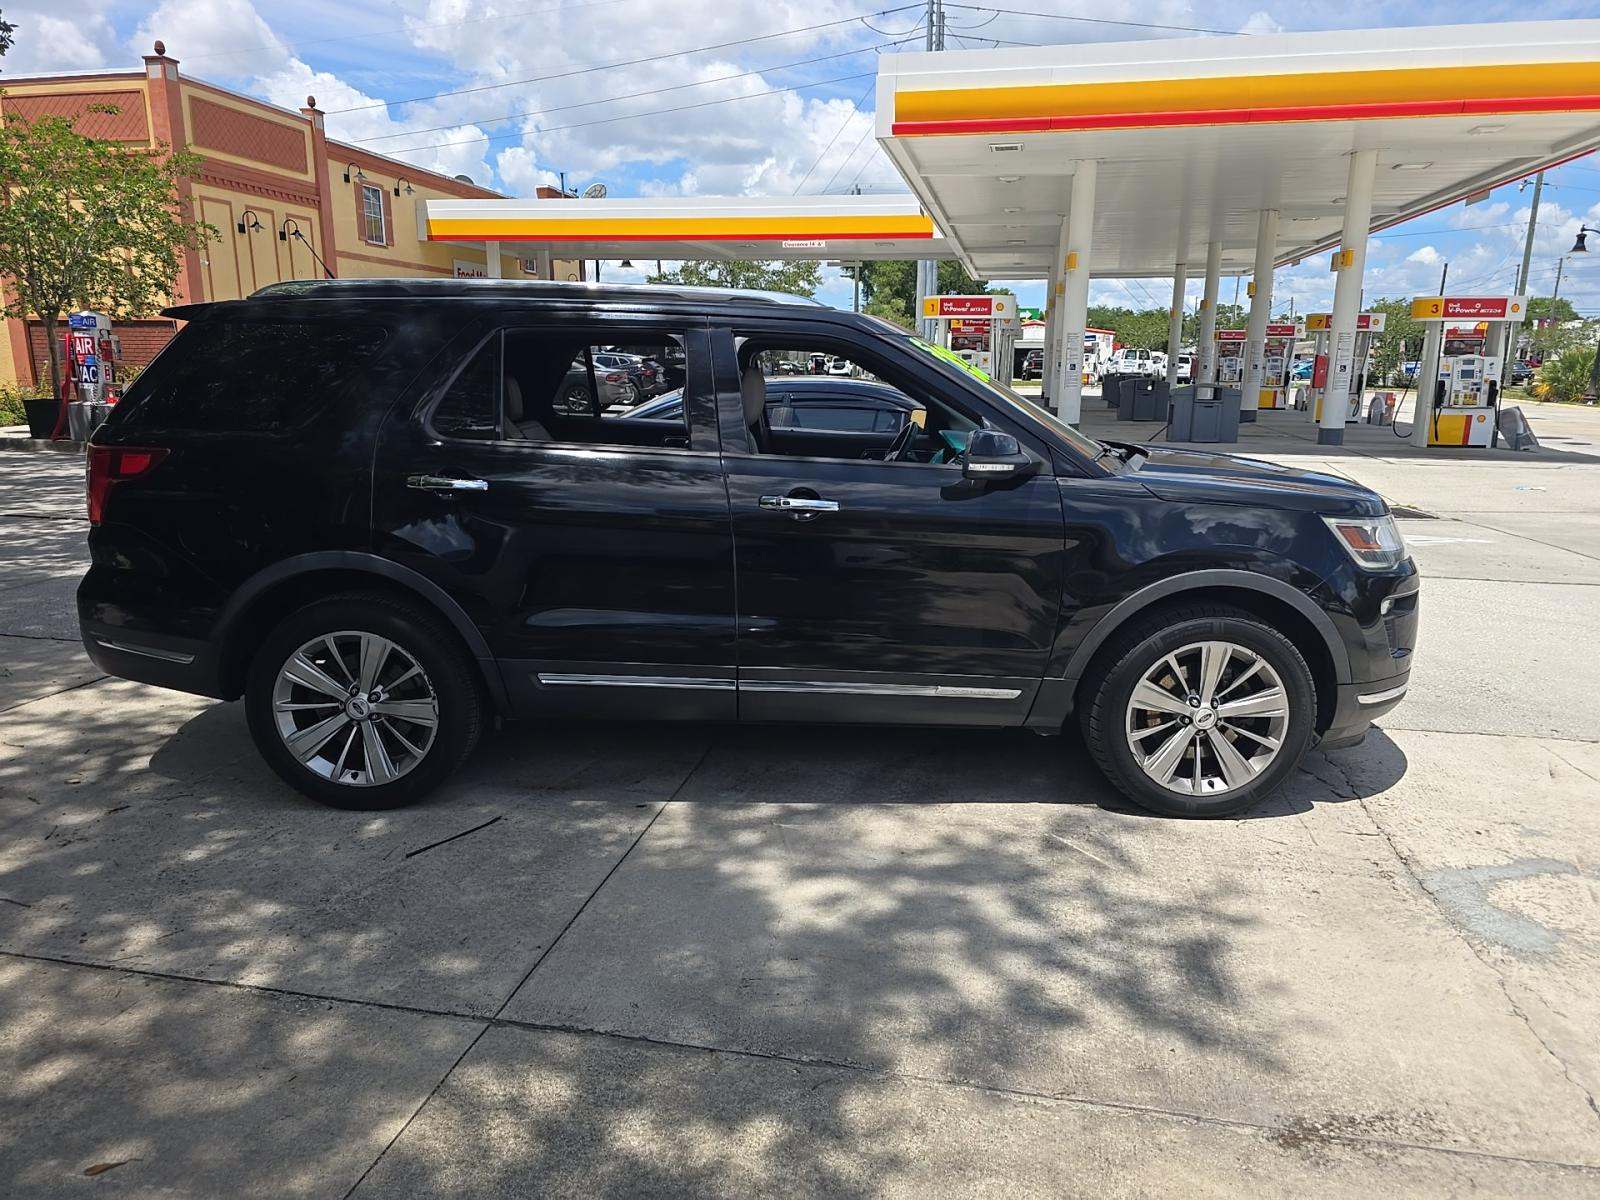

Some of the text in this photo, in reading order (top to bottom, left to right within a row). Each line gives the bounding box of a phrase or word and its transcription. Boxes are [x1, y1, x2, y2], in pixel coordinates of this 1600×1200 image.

[930, 303, 936, 312] 1
[1431, 304, 1439, 313] 3
[75, 337, 93, 355] AIR
